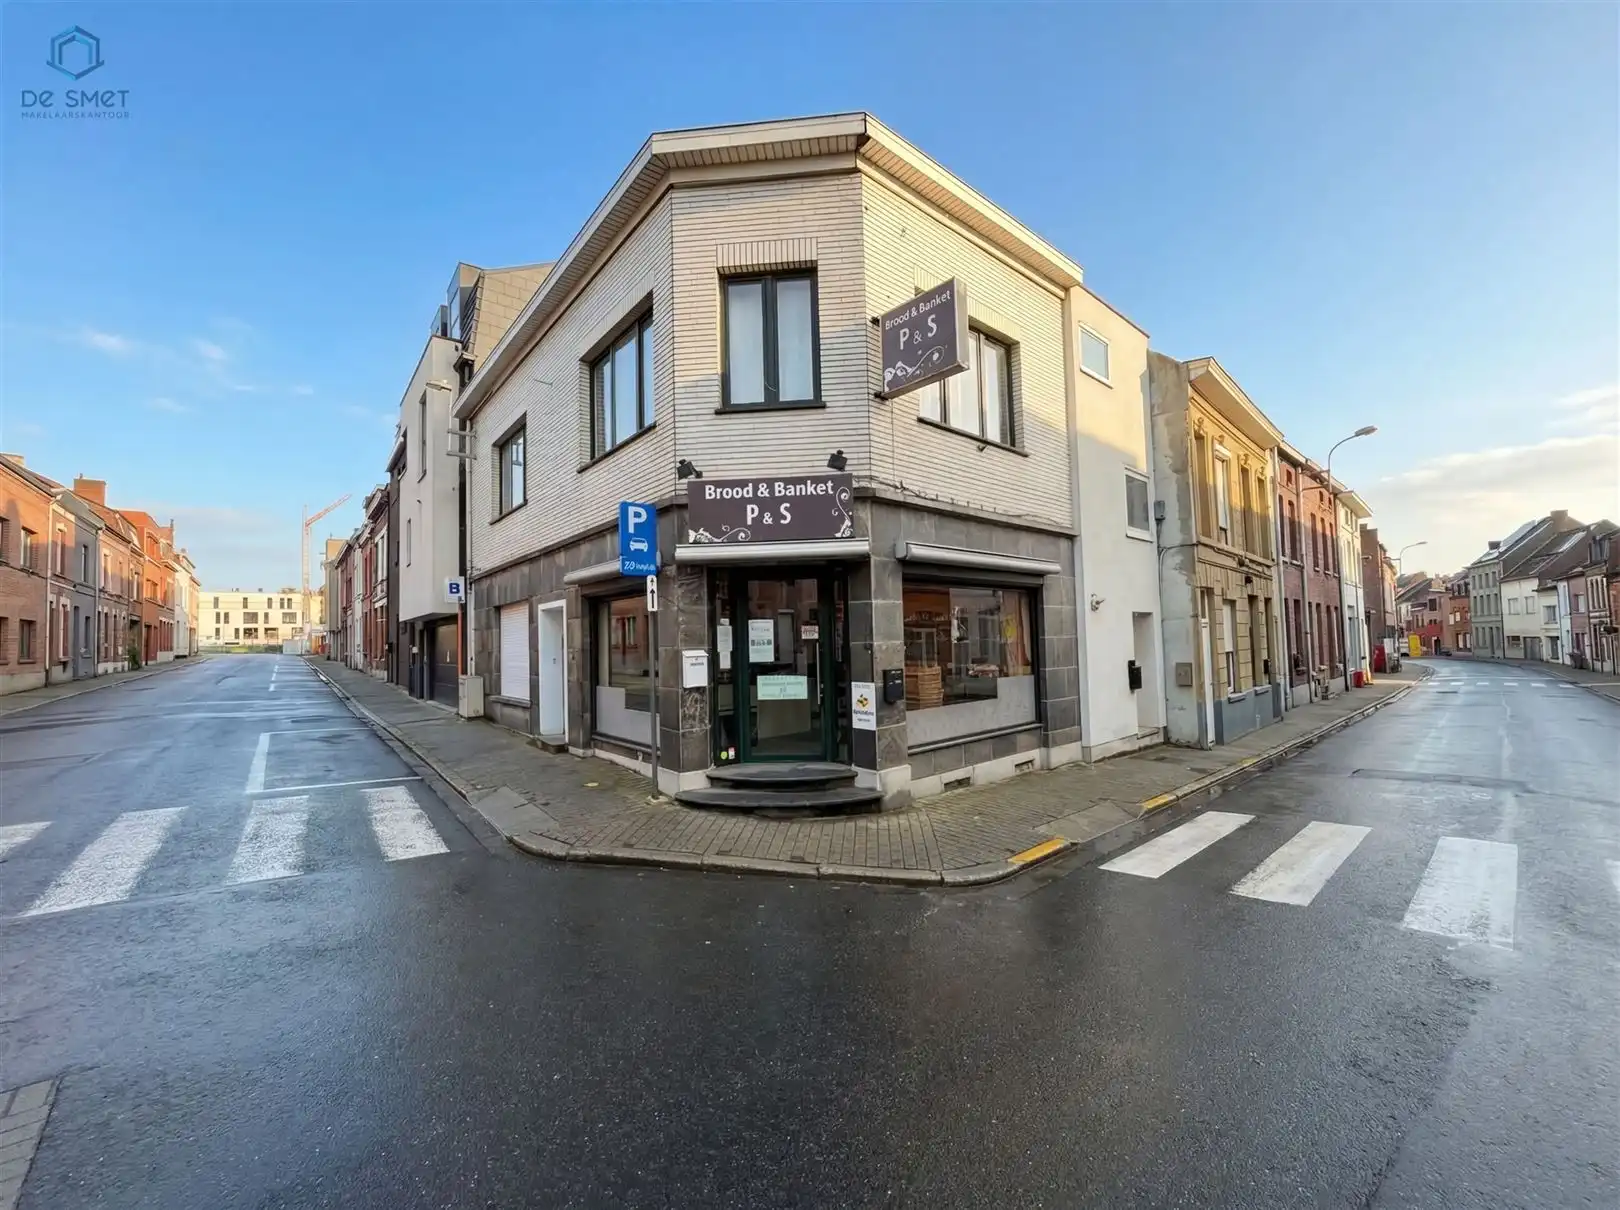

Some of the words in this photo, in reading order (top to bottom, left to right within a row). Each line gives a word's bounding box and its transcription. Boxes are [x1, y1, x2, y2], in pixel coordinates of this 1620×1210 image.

[885, 310, 909, 330] Brood
[911, 306, 918, 318] &
[919, 290, 951, 313] Banket
[900, 328, 910, 350] P
[913, 330, 922, 344] &
[927, 314, 937, 337] S
[704, 483, 753, 500] Brood
[757, 482, 770, 497] &
[774, 480, 834, 497] Banket
[628, 506, 647, 534] P
[746, 504, 759, 525] P
[762, 512, 773, 525] &
[780, 503, 792, 524] S
[449, 583, 460, 594] B
